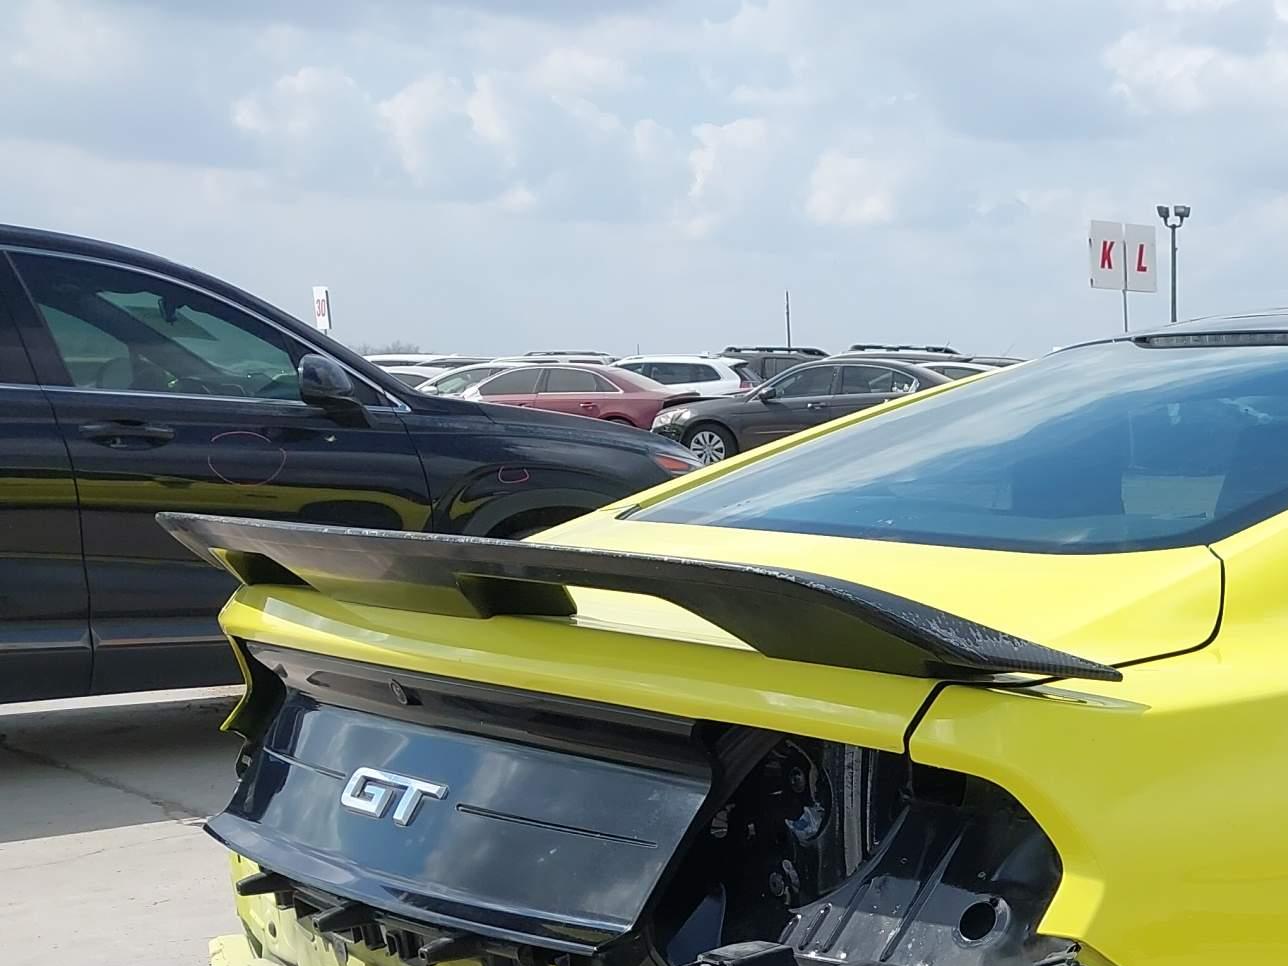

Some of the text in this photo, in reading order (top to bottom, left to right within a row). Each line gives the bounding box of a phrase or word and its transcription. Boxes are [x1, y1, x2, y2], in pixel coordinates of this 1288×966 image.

[1100, 240, 1147, 272] K L
[316, 298, 326, 317] 30
[341, 767, 449, 826] GT
